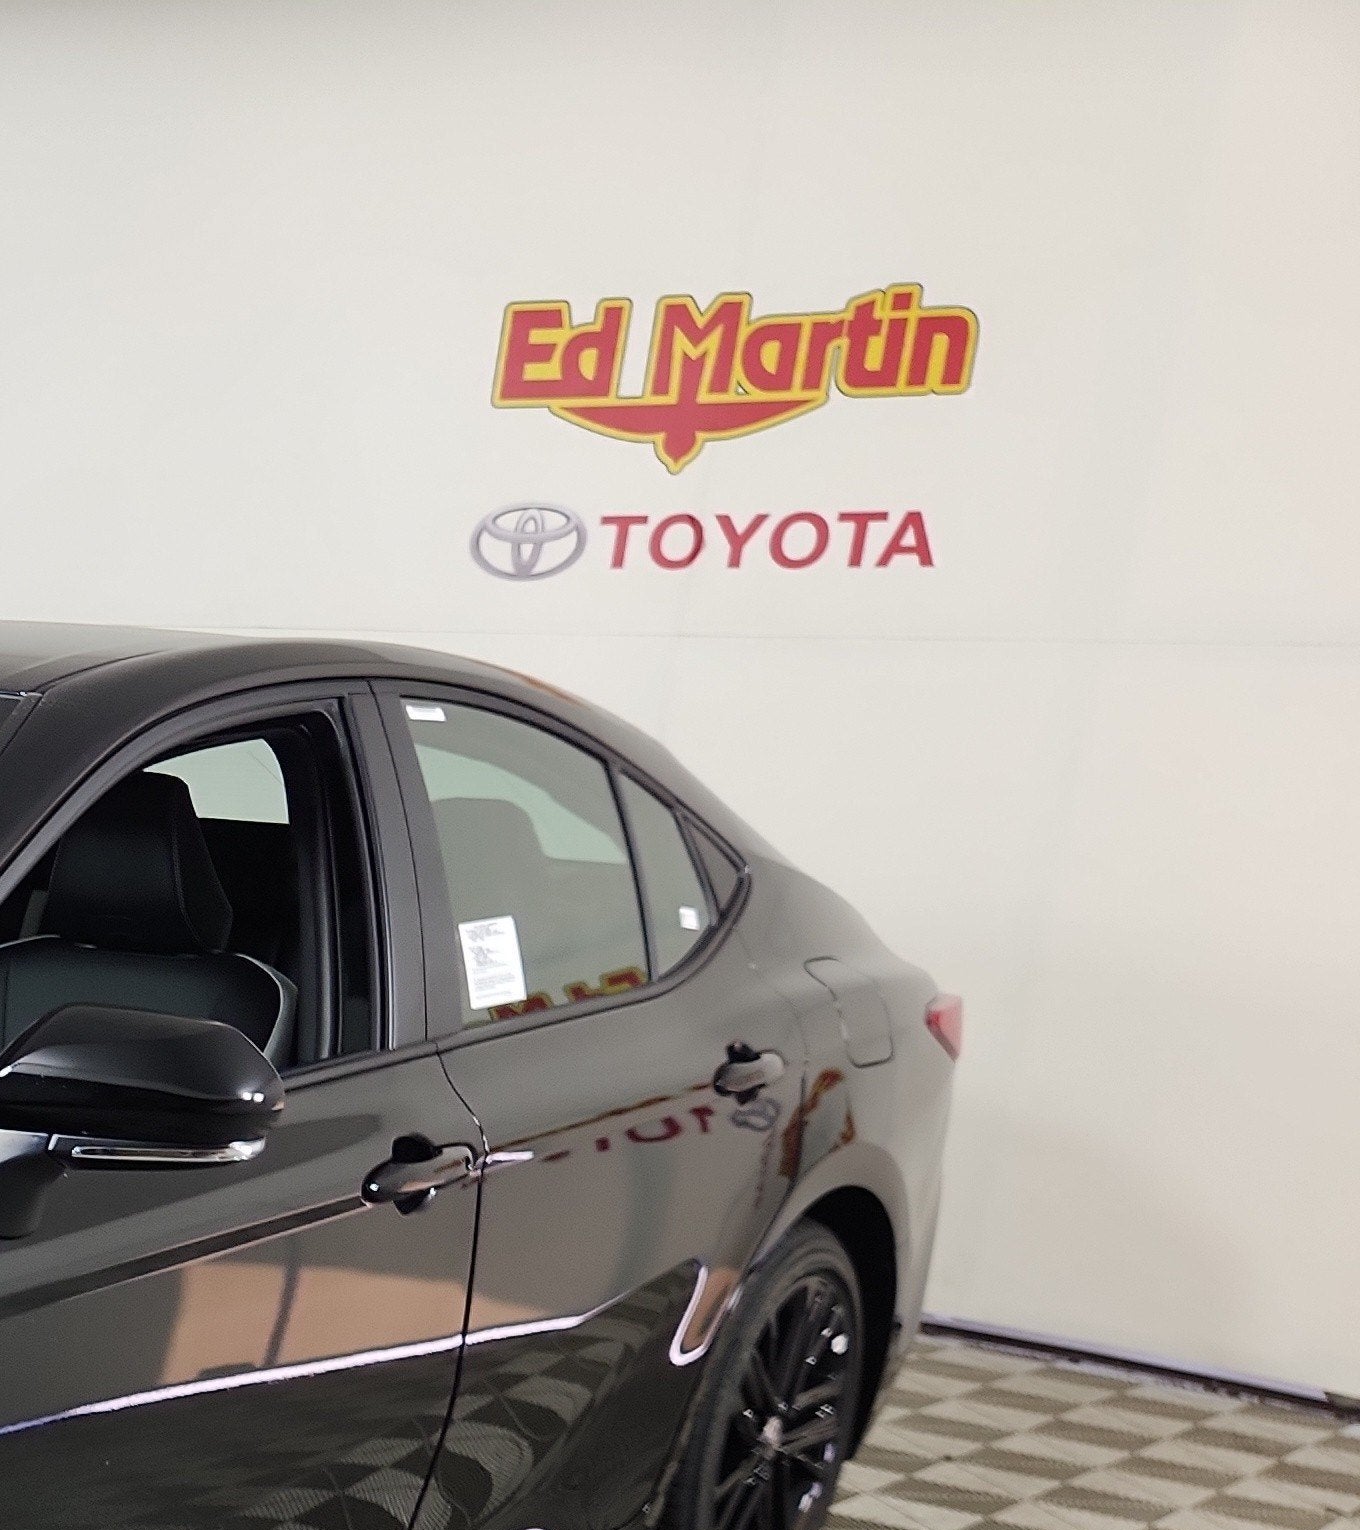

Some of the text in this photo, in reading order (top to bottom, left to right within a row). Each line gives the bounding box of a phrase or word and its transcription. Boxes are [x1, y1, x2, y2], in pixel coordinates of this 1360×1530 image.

[491, 282, 979, 408] Ed Martin
[599, 509, 935, 570] TOYOTA
